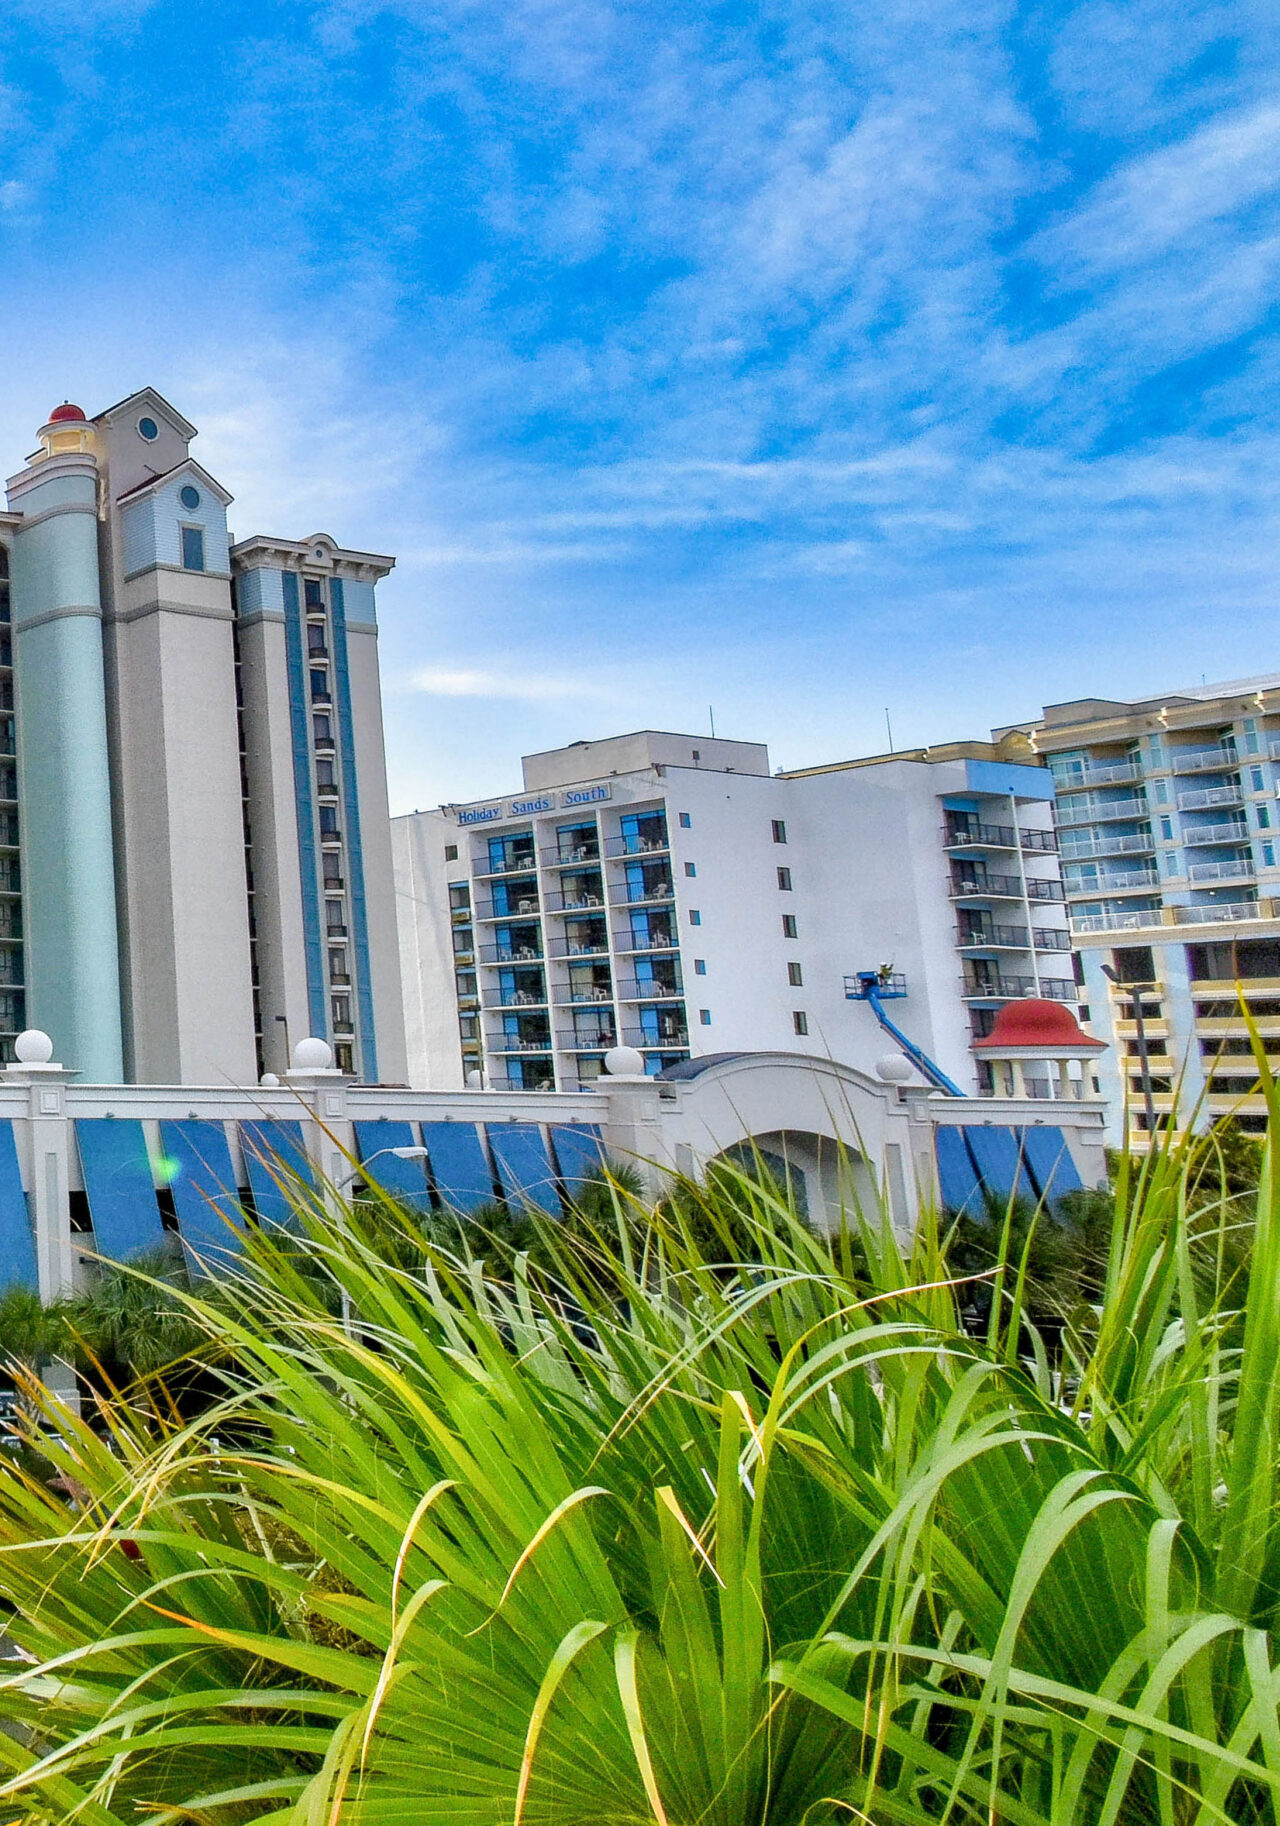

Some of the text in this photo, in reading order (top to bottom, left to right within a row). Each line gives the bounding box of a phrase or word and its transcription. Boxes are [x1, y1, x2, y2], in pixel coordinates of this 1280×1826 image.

[458, 786, 606, 824] Holiday Sands South
